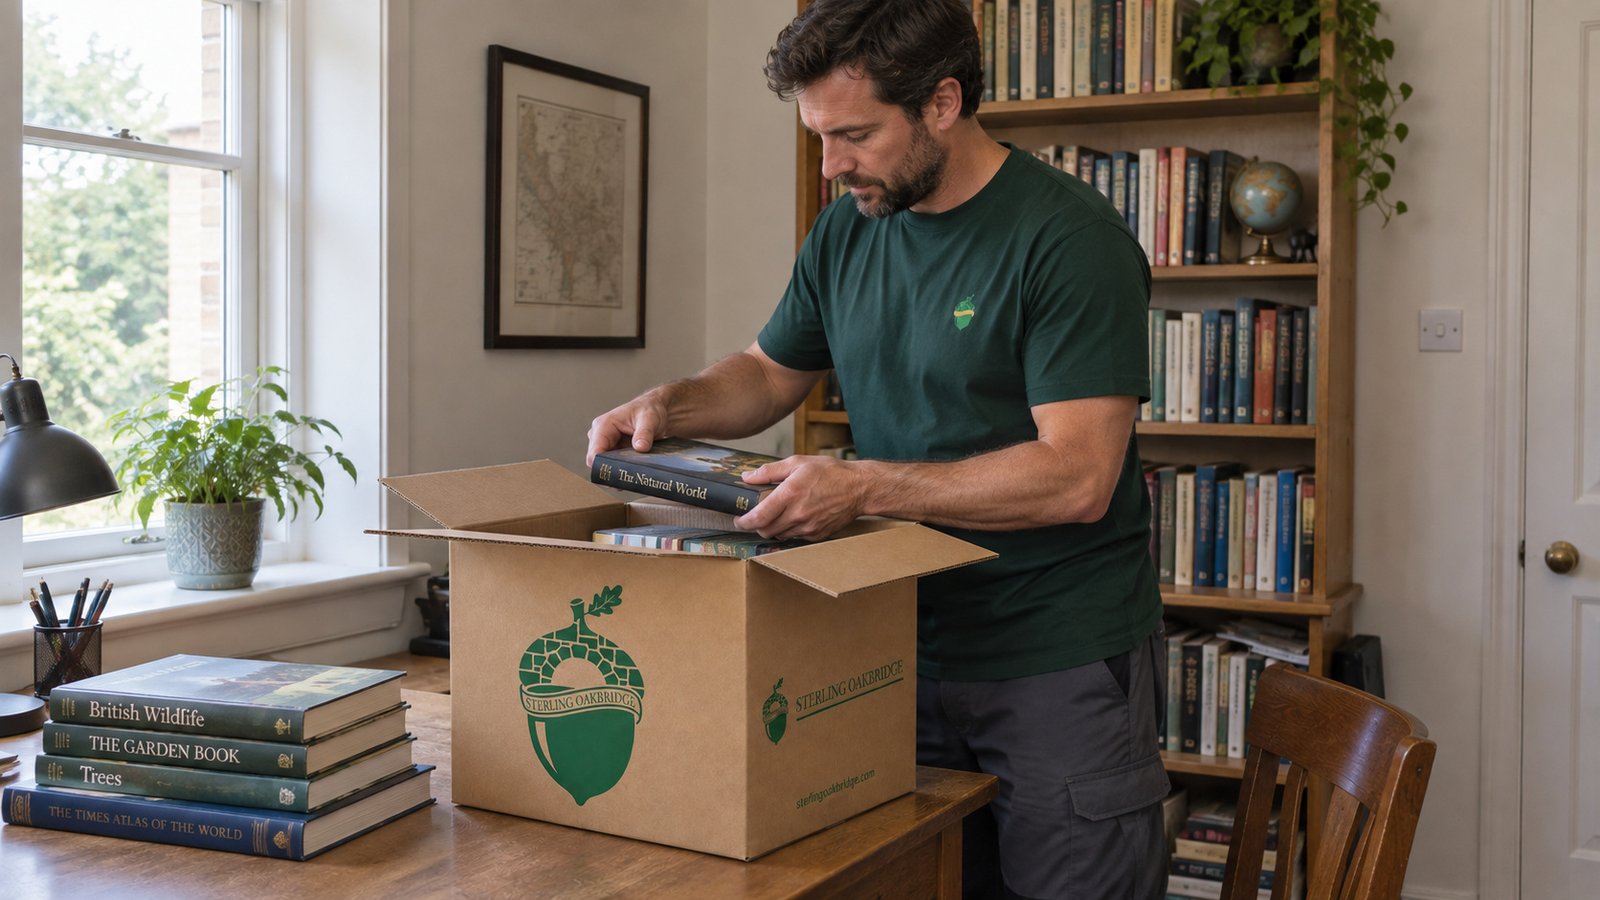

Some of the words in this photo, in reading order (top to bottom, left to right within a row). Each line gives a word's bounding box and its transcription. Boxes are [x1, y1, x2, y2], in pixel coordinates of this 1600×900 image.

[676, 481, 708, 500] World
[795, 680, 847, 713] STERLING
[848, 659, 904, 692] OAKBRIDGE
[89, 701, 140, 721] British
[144, 705, 205, 728] Wildlife
[525, 696, 574, 712] STERLING
[575, 691, 636, 708] OAKBRIDGE
[89, 735, 121, 753] THE
[123, 739, 190, 759] GARDEN
[194, 745, 241, 764] BOOK
[80, 765, 122, 787] Trees
[49, 806, 72, 819] THE
[75, 809, 110, 824] TIMES
[112, 814, 148, 828] ATLAS
[151, 818, 167, 830] OF
[170, 820, 195, 834] THE
[198, 824, 243, 841] WORLD
